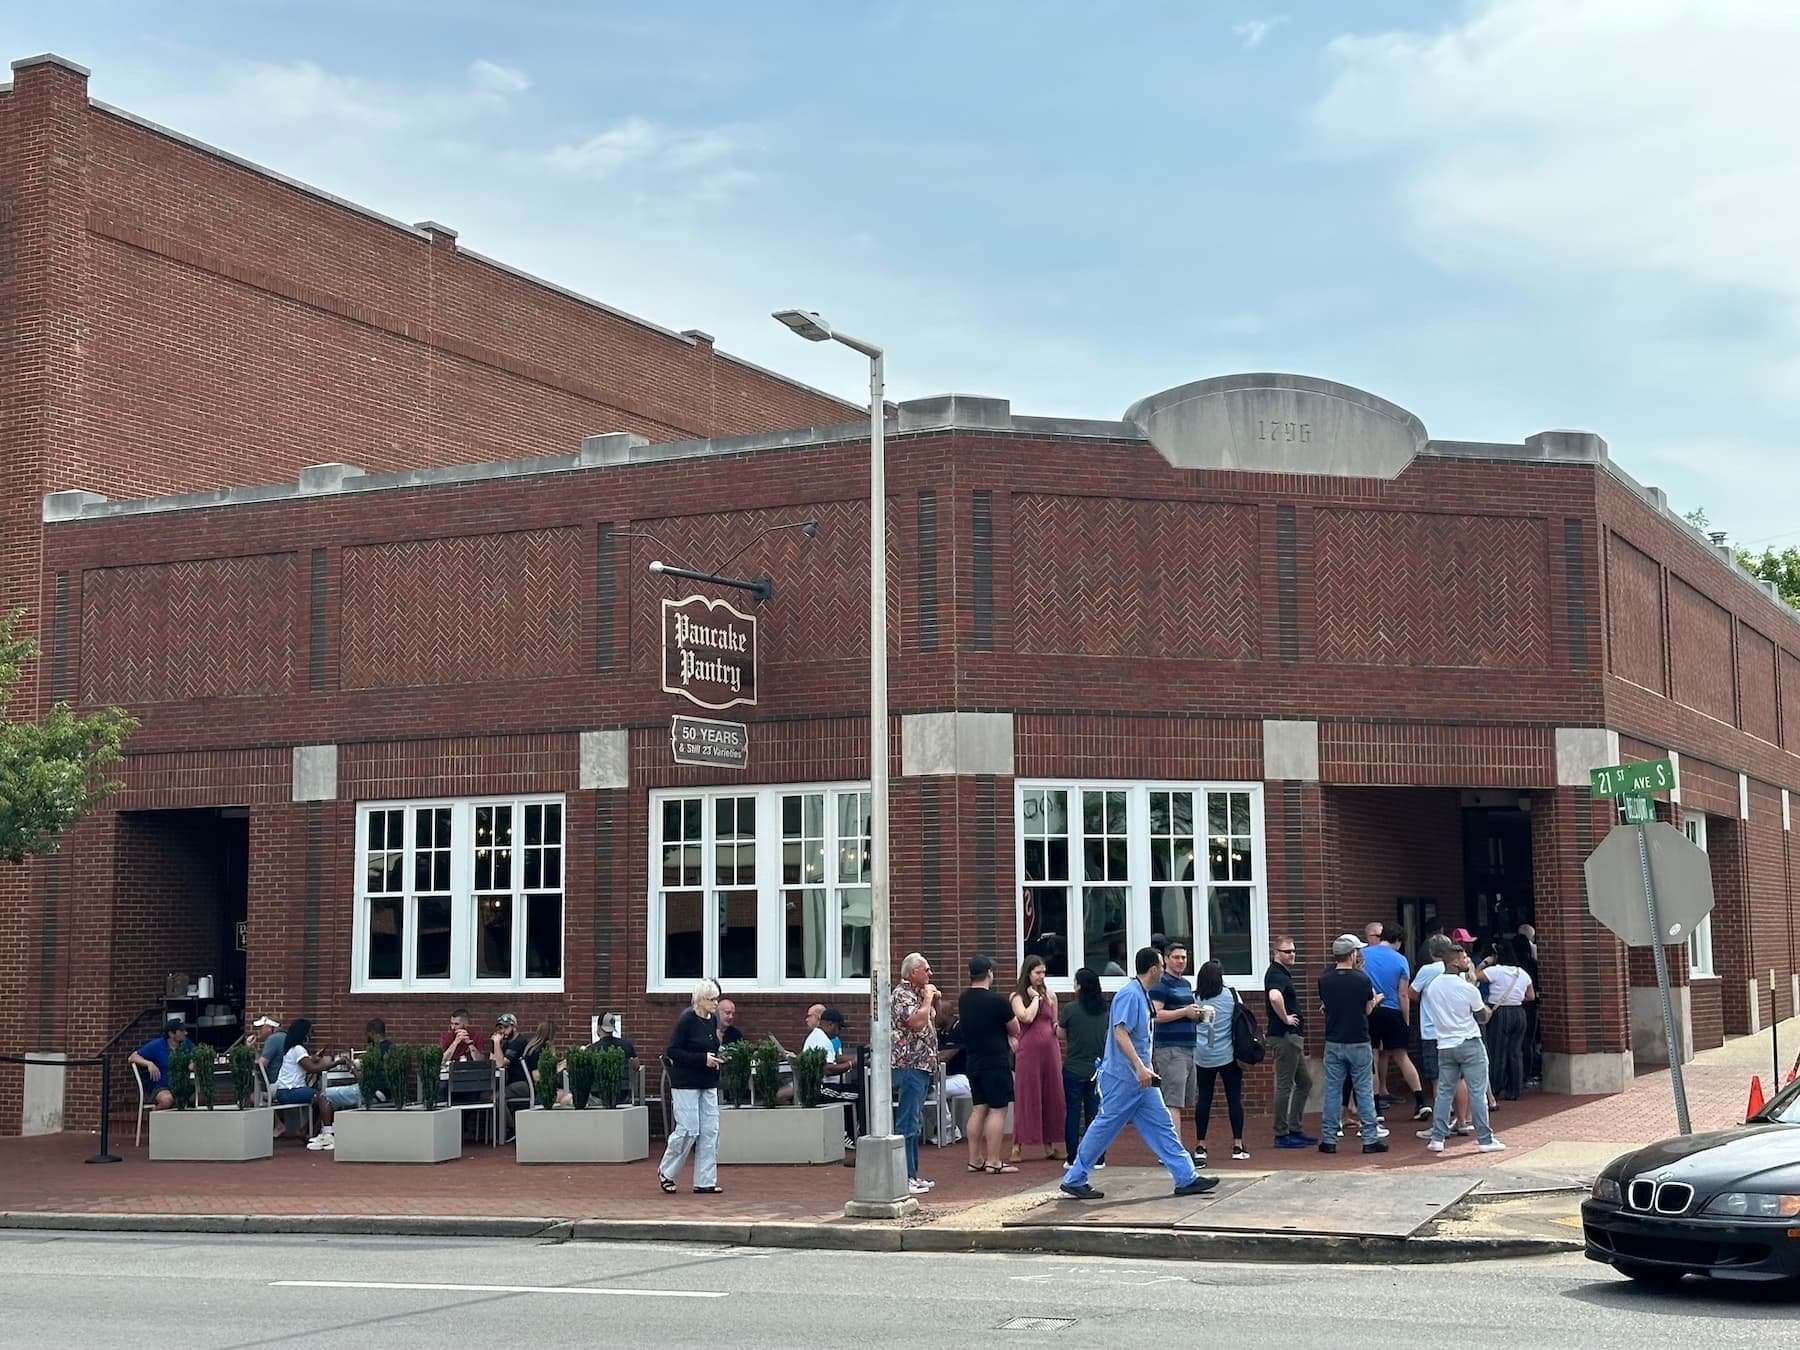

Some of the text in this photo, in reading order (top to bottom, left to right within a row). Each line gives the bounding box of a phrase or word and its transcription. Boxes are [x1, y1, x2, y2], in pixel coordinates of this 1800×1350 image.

[1259, 420, 1311, 443] 1796
[674, 612, 747, 653] Pancake
[680, 649, 741, 693] Pantry
[682, 726, 739, 745] 50 YEARS
[713, 746, 742, 759] Varieties
[1598, 764, 1666, 794] 21 ST AVE S
